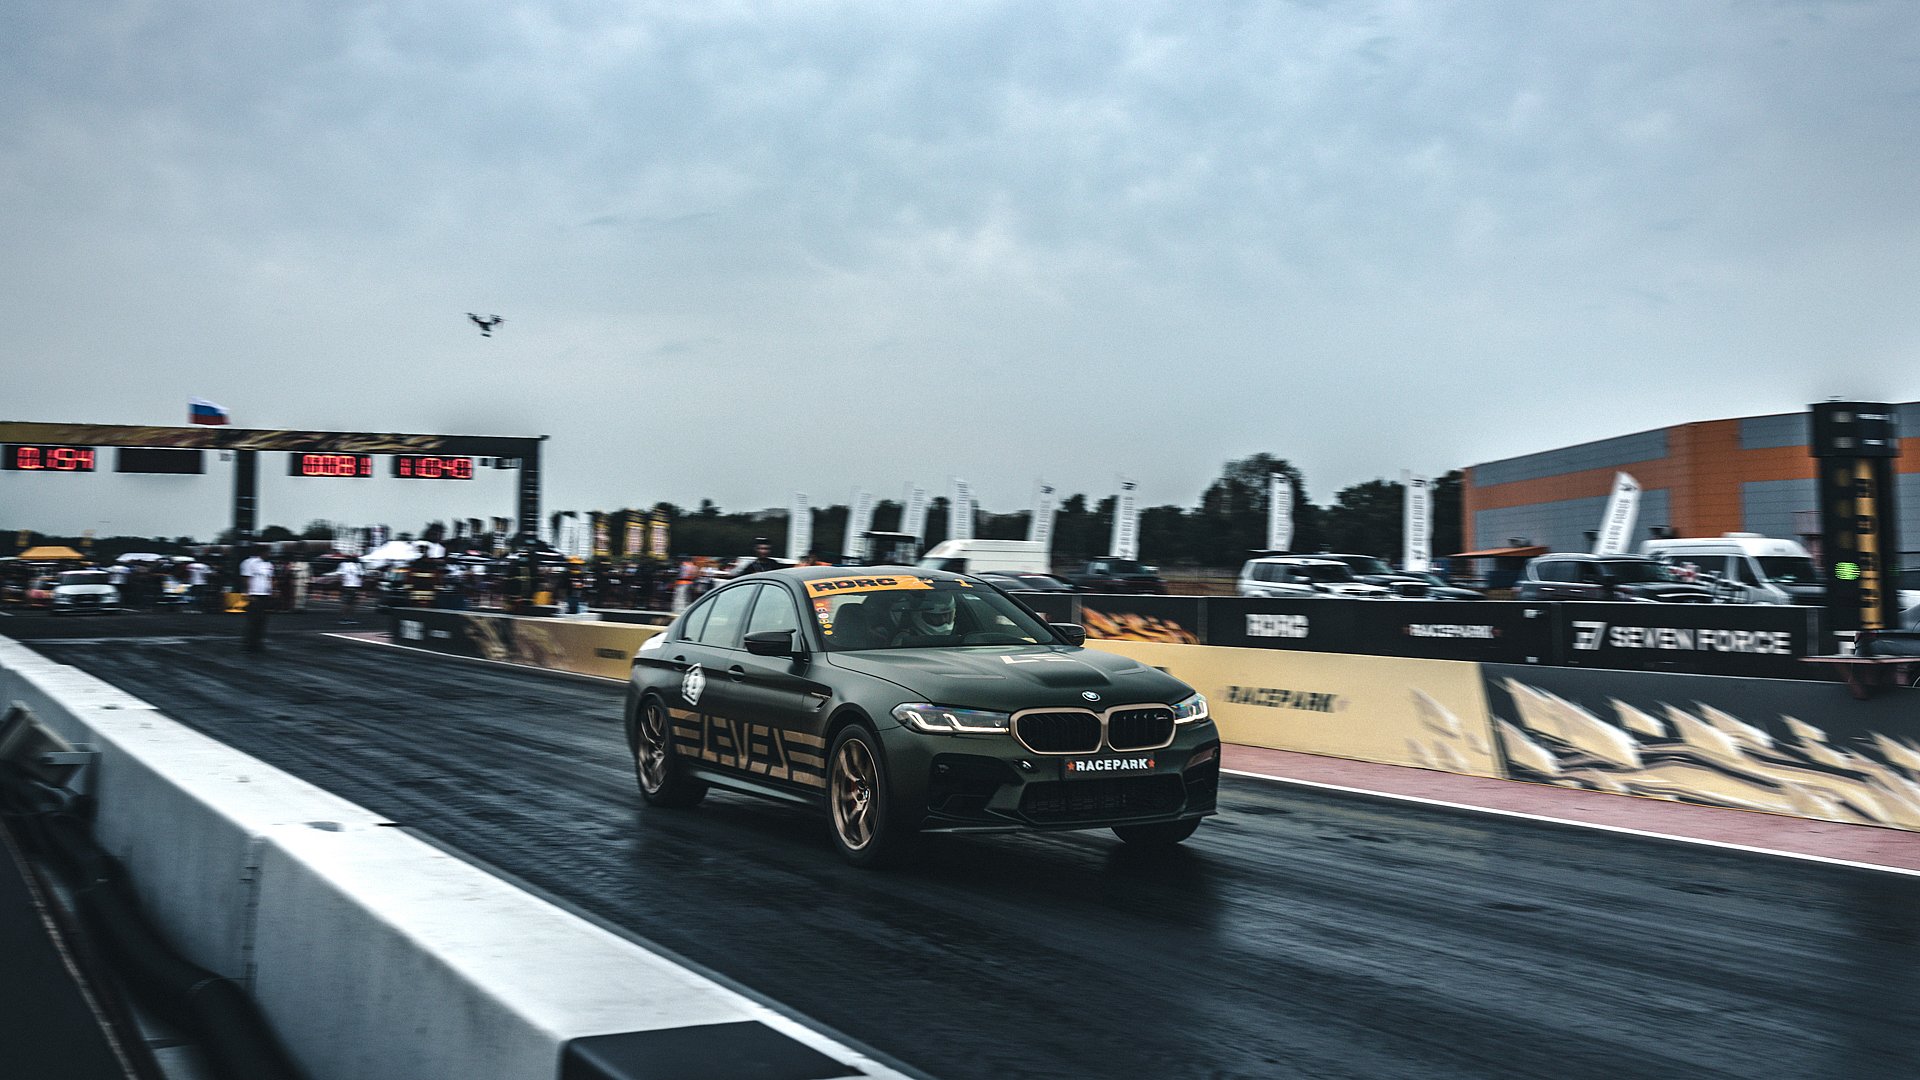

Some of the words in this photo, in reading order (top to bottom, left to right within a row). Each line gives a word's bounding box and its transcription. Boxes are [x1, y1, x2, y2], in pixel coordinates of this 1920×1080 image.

[811, 578, 898, 592] RDRC
[1609, 626, 1695, 650] SEVEN
[1697, 629, 1792, 655] FORCE
[1075, 758, 1148, 772] RACEPARK
